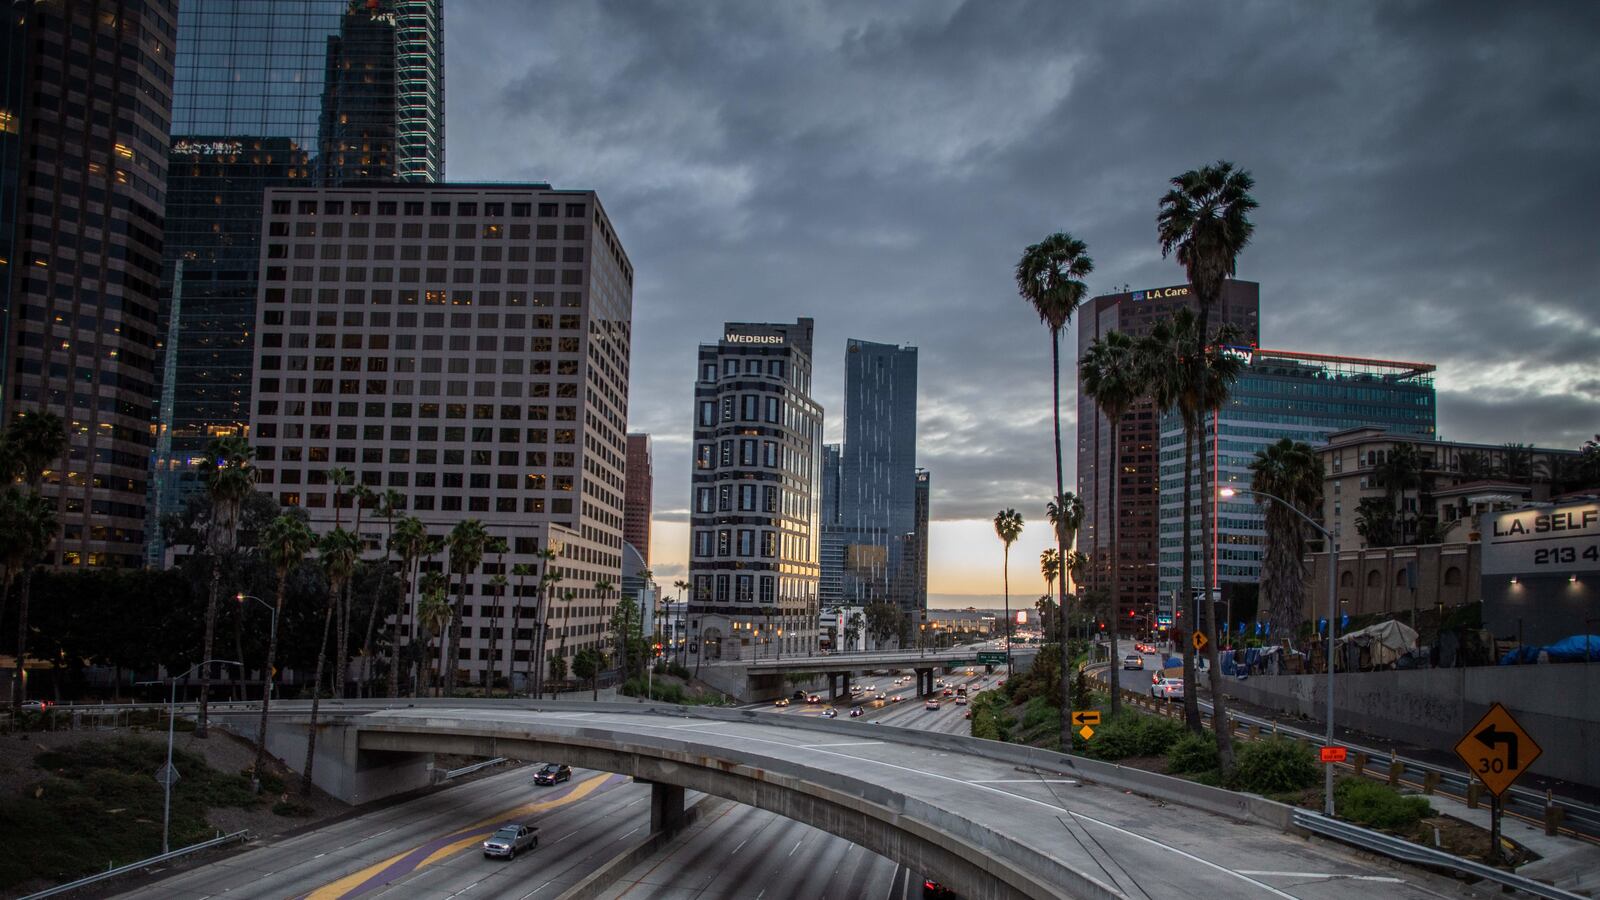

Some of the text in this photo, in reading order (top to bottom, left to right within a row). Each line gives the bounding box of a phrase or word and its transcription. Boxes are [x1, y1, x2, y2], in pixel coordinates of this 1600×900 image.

[1164, 287, 1188, 297] Care
[726, 334, 784, 344] WEDBUSH
[1493, 510, 1598, 537] L.A. SELF
[1534, 547, 1576, 565] 213
[1479, 758, 1504, 774] 30
